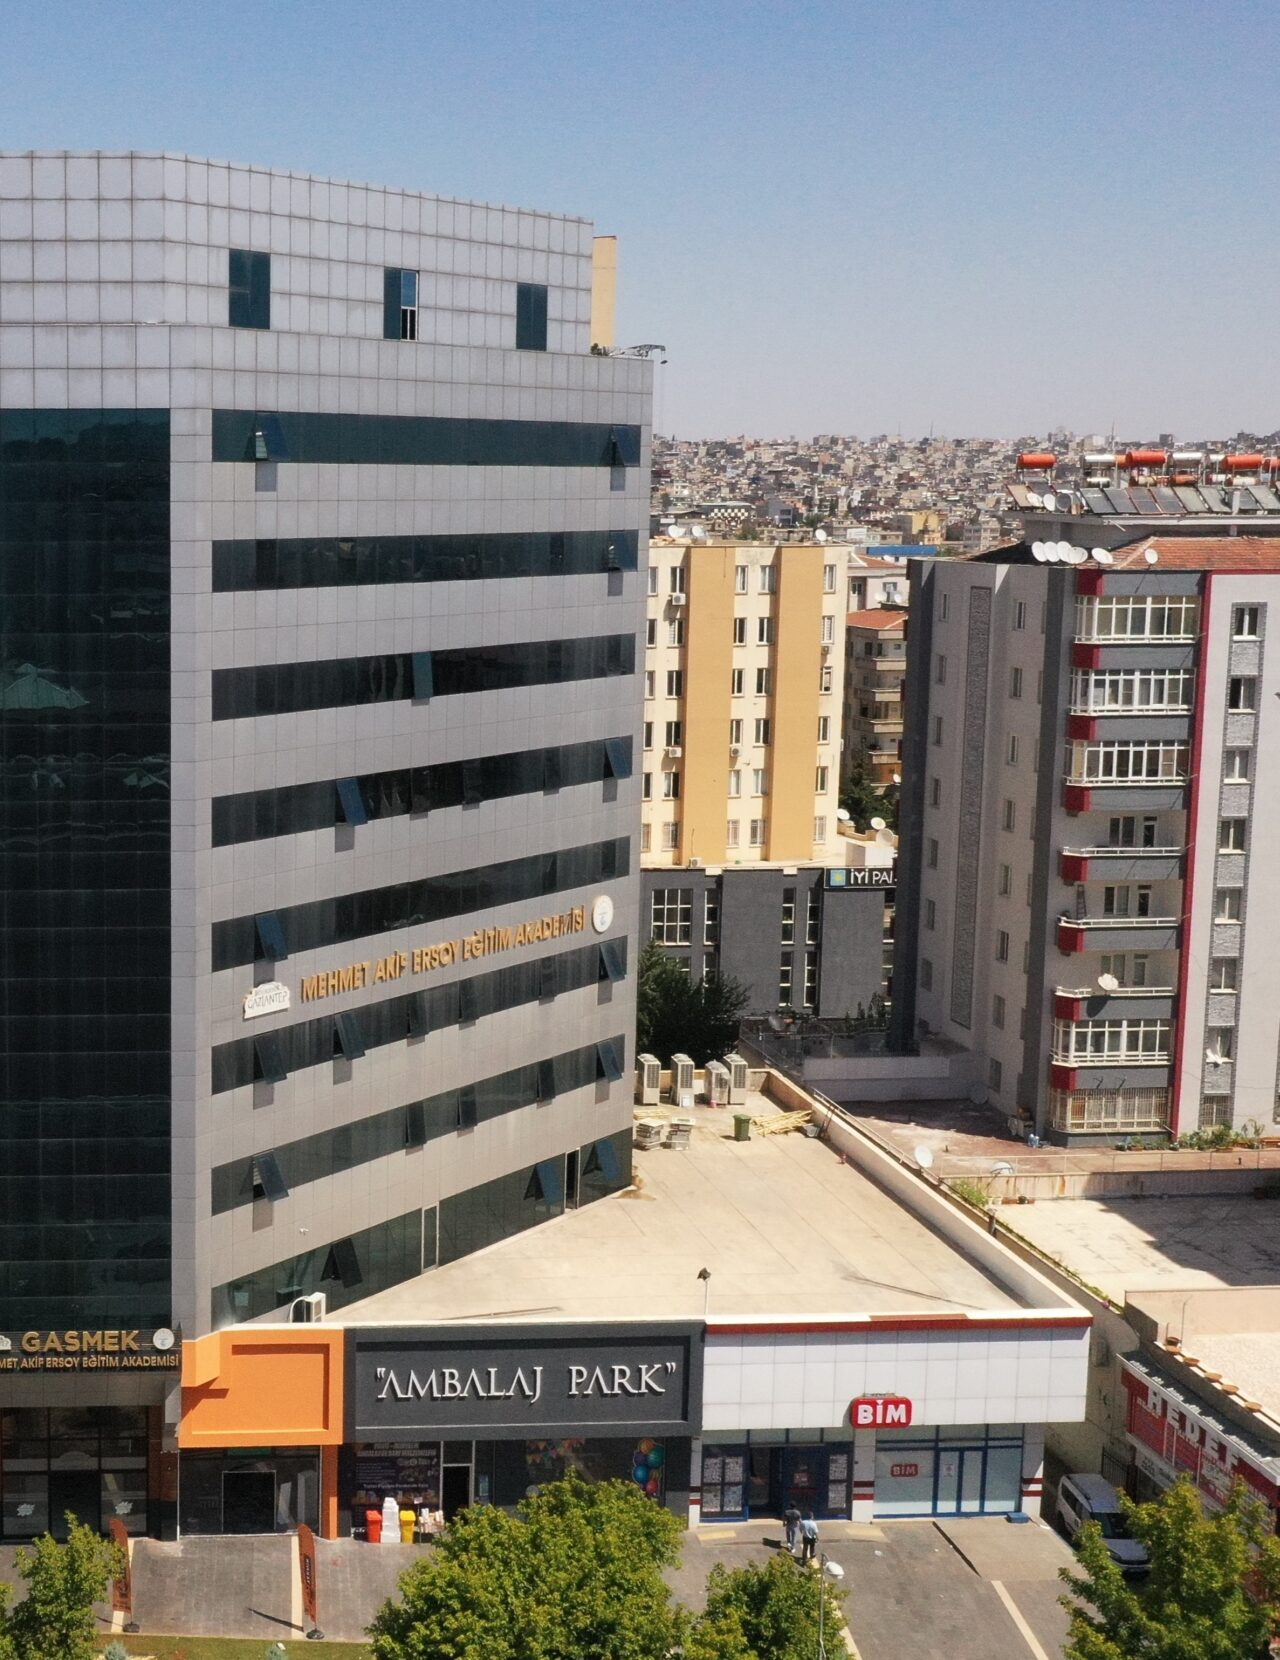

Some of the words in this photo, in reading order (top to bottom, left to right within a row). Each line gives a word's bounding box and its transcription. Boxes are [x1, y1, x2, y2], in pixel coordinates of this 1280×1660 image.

[850, 869, 869, 885] İYİ
[301, 961, 371, 1001] MEHMET
[374, 951, 407, 983] AKİF
[412, 939, 461, 973] ERSOY
[462, 925, 511, 961] EĞİTİM
[514, 904, 586, 948] AKADEMİSİ
[21, 1330, 141, 1352] GASMEK
[21, 1355, 44, 1369] AKİF
[46, 1357, 80, 1368] ERSOY
[83, 1354, 119, 1368] EĞİTİM
[122, 1354, 180, 1367] AKADEMİSİ
[857, 1399, 907, 1425] BİM
[1146, 1384, 1239, 1474] HEDEF
[892, 1465, 916, 1475] BİM
